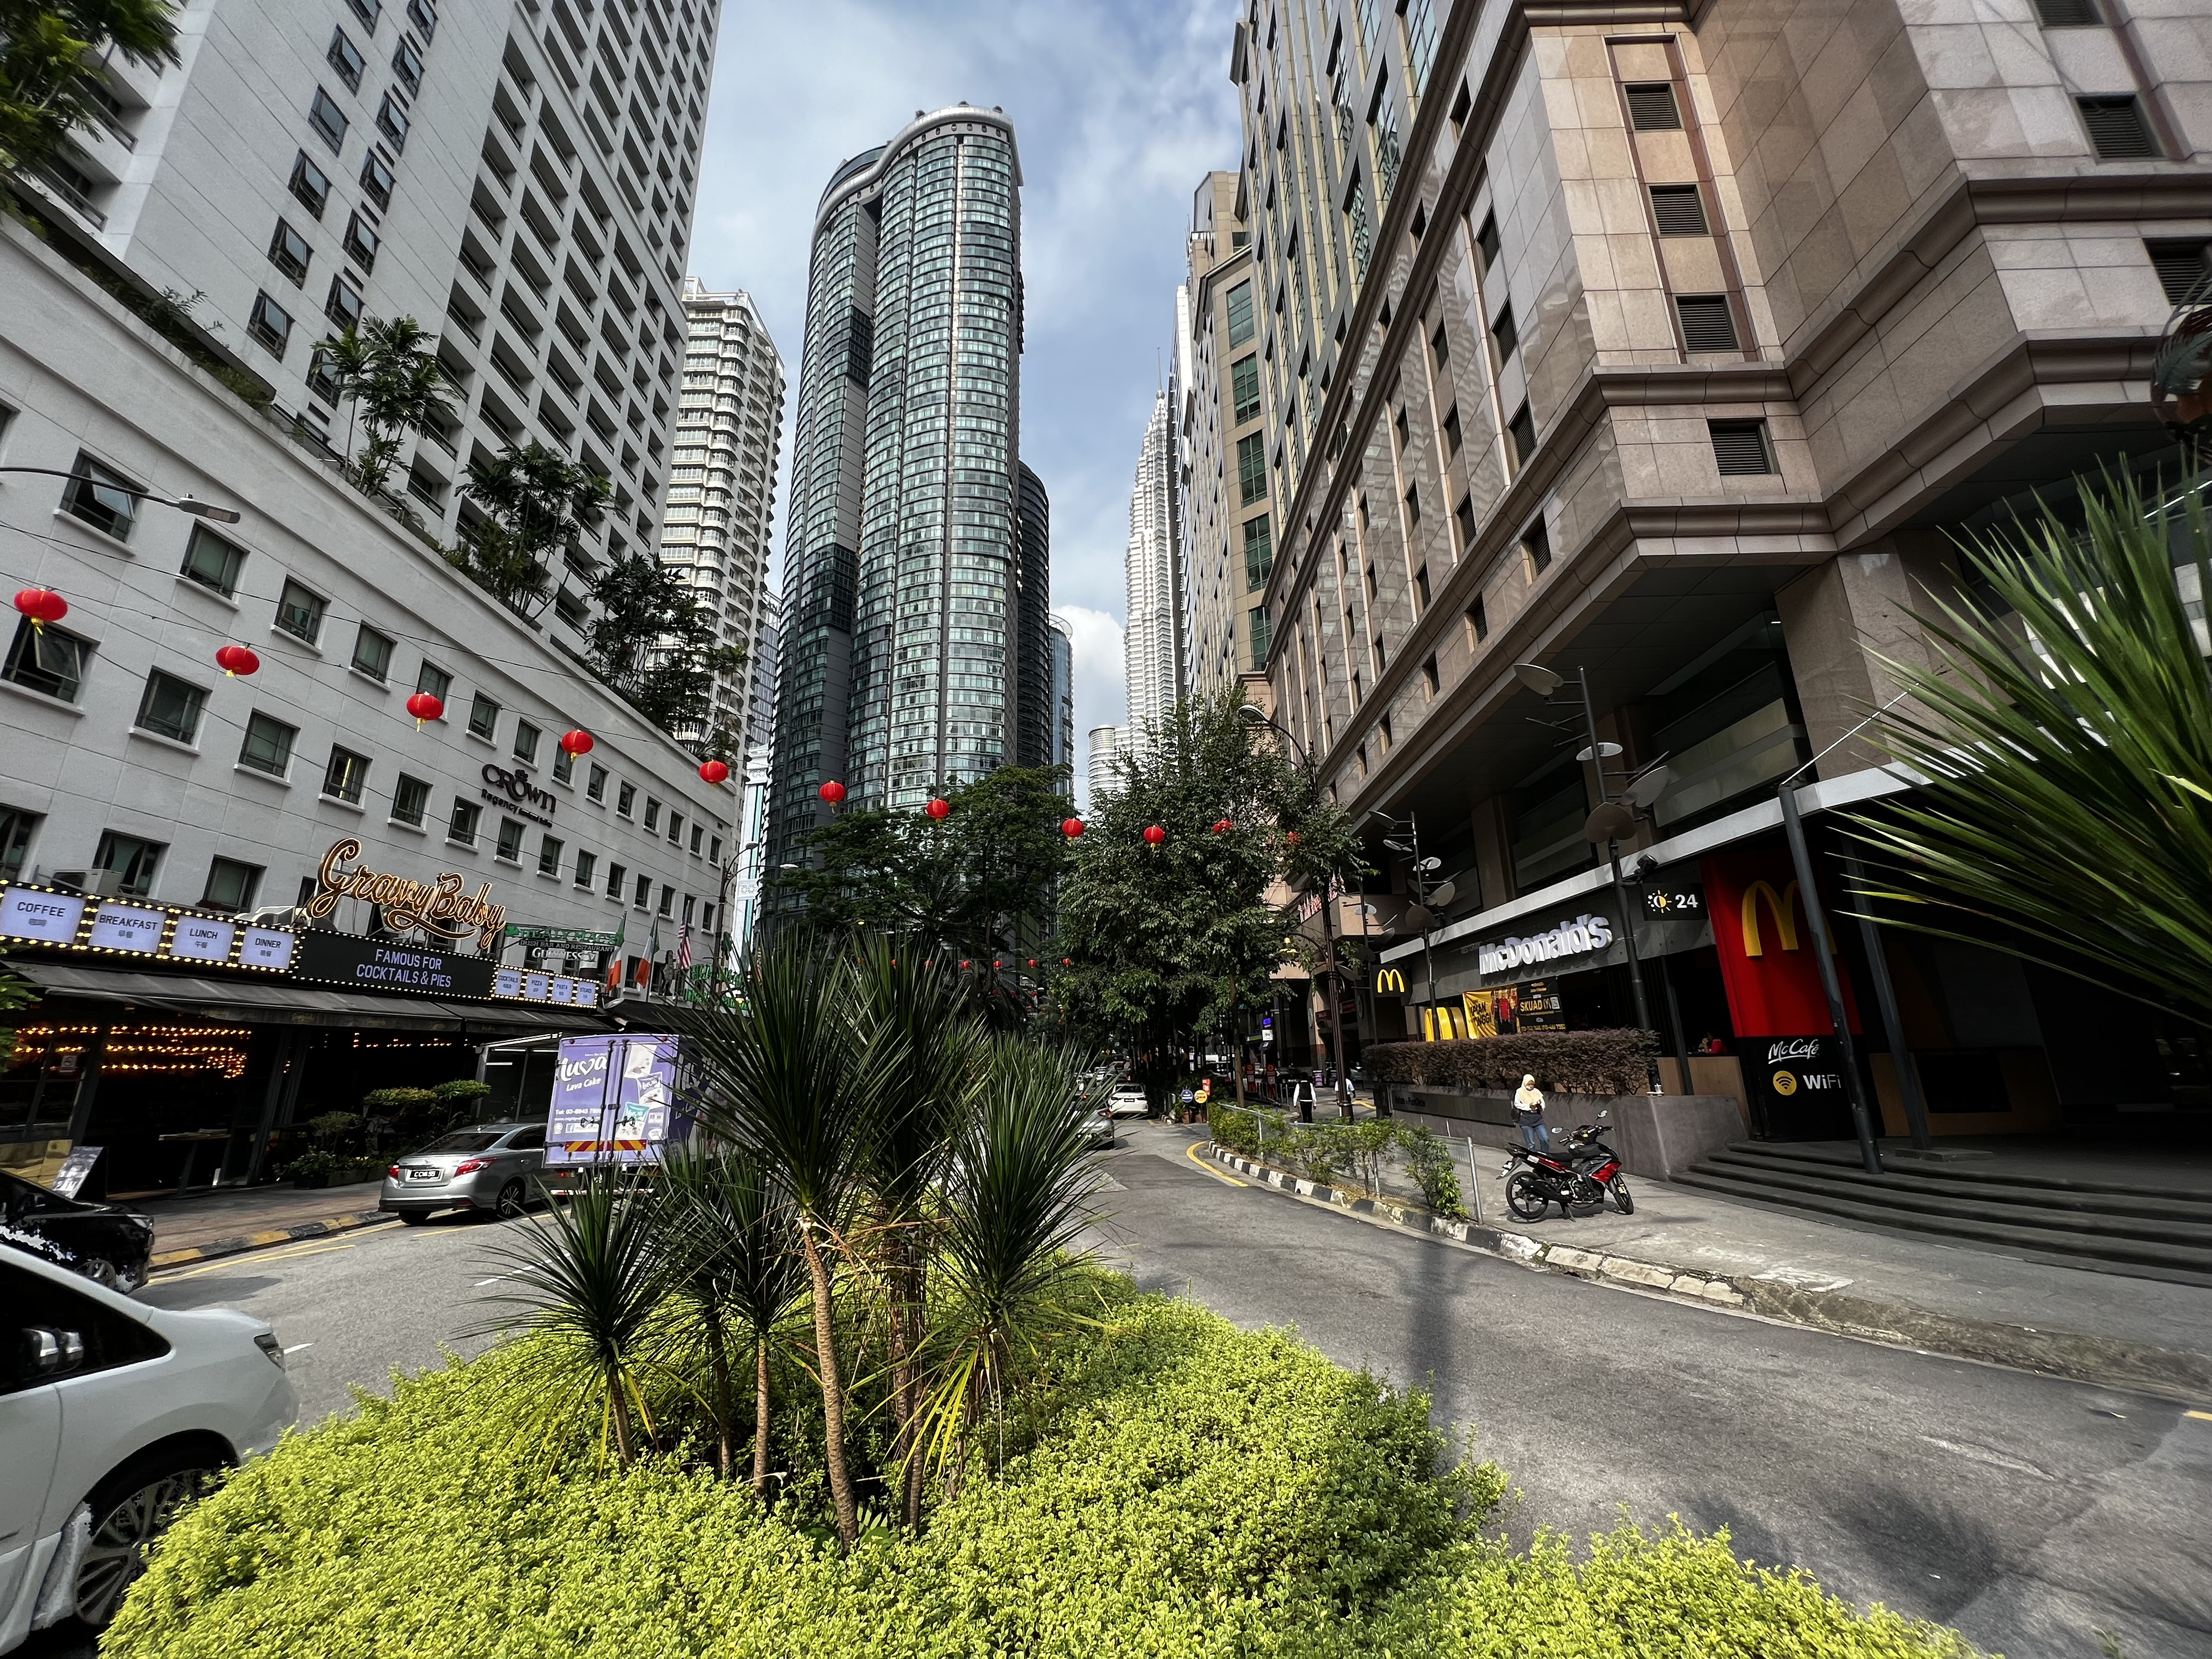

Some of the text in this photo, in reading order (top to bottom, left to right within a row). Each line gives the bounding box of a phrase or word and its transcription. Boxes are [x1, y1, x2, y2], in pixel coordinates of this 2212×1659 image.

[307, 837, 506, 949] Gravy Baby
[1675, 894, 1698, 909] 24
[17, 902, 66, 917] COFFEE
[98, 914, 158, 930] BREAKFAST
[190, 928, 218, 940] LUNCH
[255, 938, 281, 948] DINNER
[571, 944, 614, 952] RESTAURANT
[1479, 914, 1613, 975] McDonald's
[375, 949, 442, 971] FAMOUS FOR
[356, 964, 452, 988] COCKTAILS & PIES
[1520, 1000, 1543, 1011] SKUAD
[566, 1077, 602, 1092] Lava Cake
[1803, 1074, 1841, 1089] WiFi
